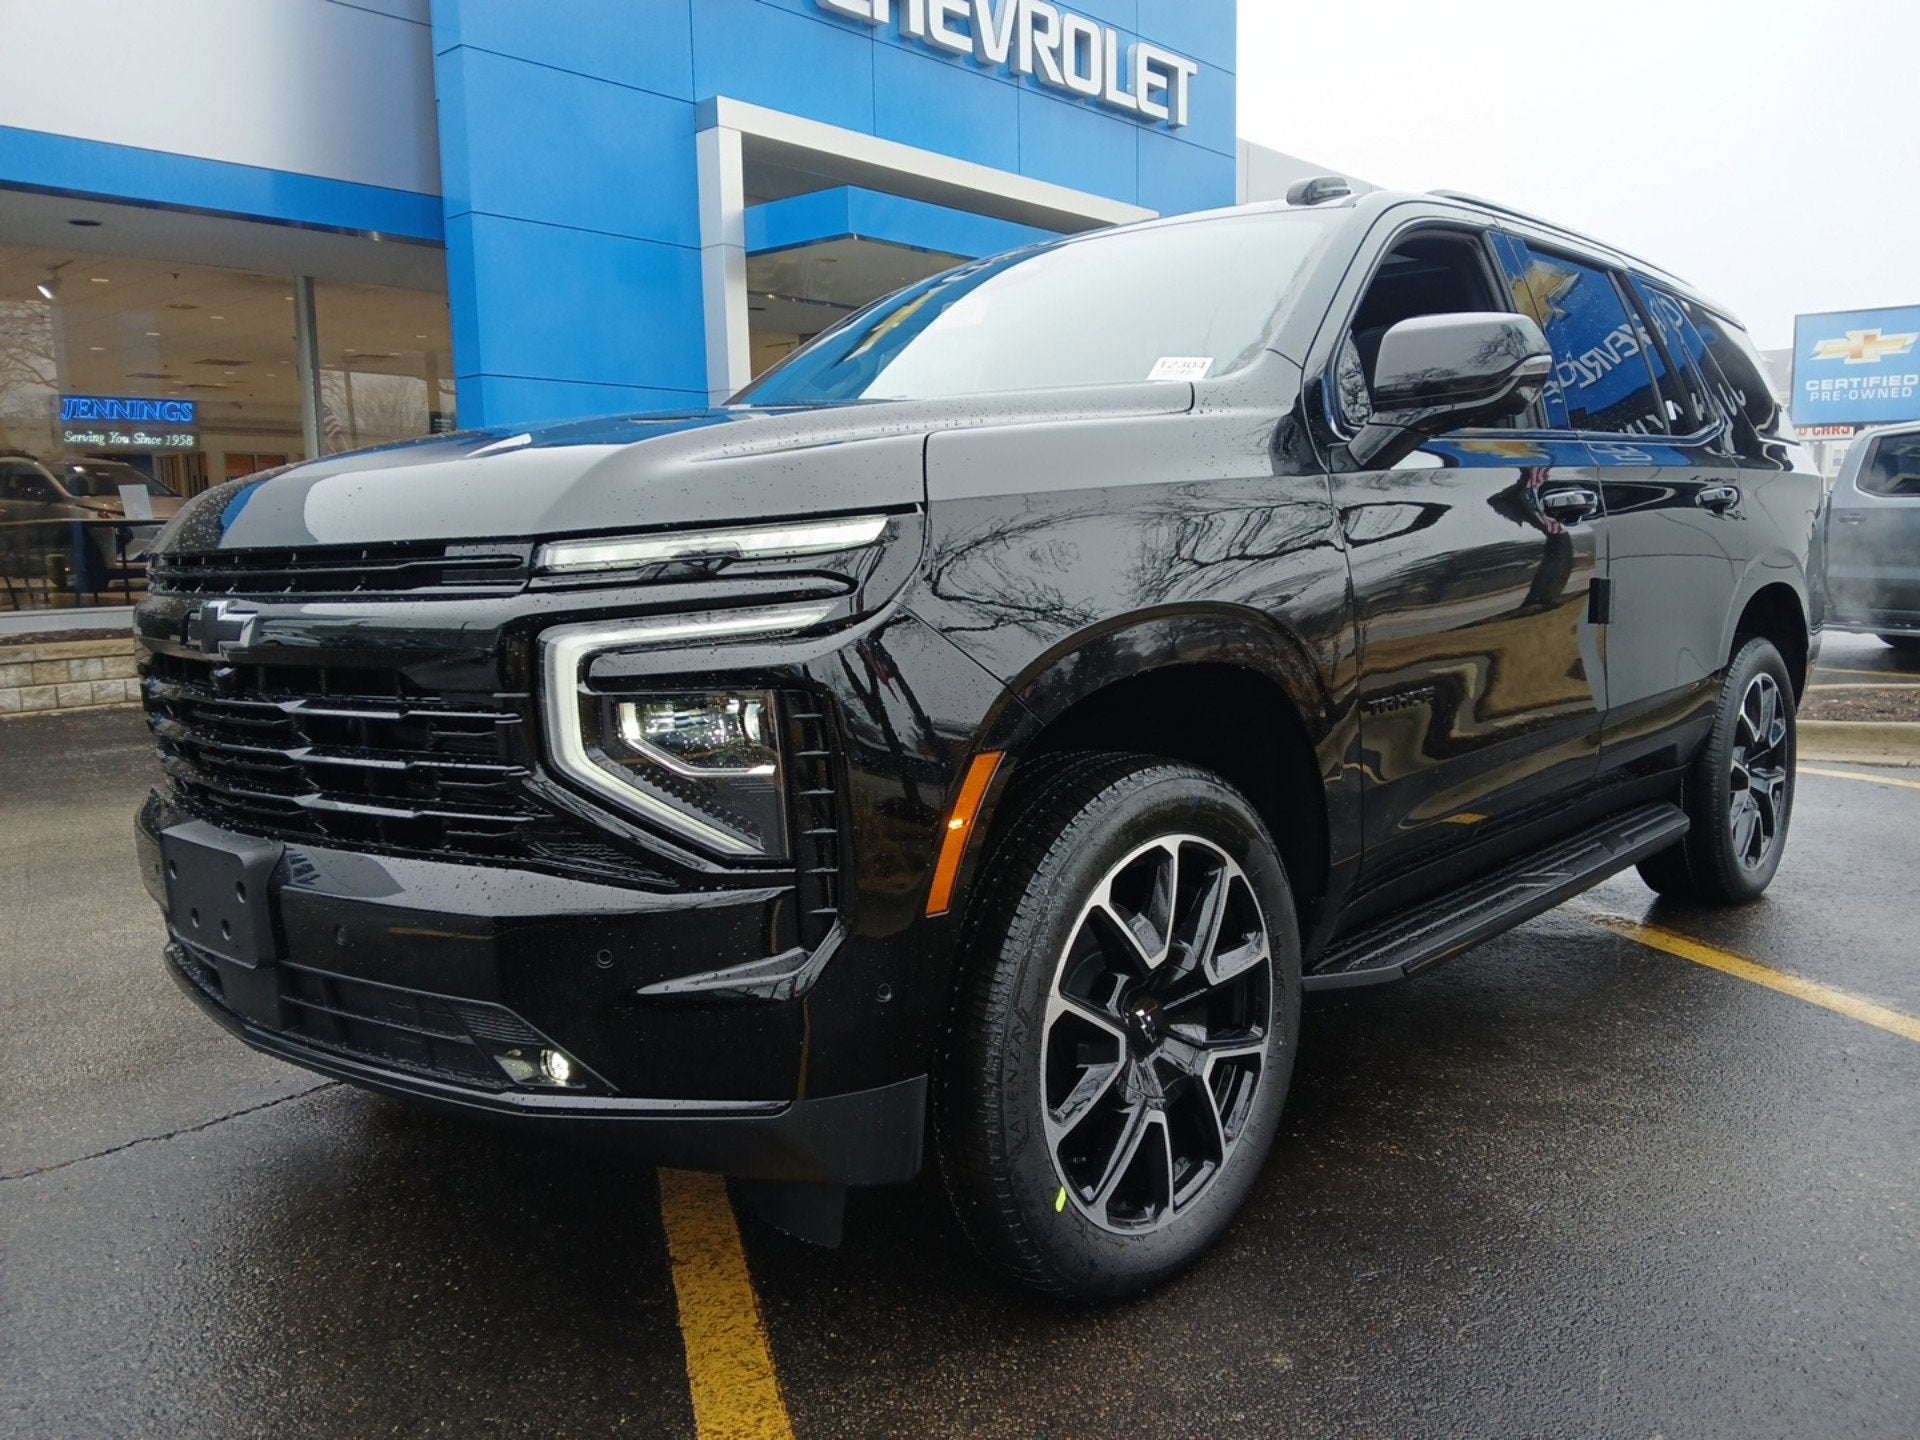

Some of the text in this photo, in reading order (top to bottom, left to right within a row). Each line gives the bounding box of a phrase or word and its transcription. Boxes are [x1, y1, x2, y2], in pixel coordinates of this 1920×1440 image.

[815, 0, 1198, 127] EVROLET
[1805, 374, 1919, 391] CERTIFIED
[1810, 387, 1913, 402] PRE-OWNED
[60, 398, 193, 421] JENNINGS
[64, 431, 194, 447] Serving You Since 1958
[1812, 426, 1850, 436] CARS
